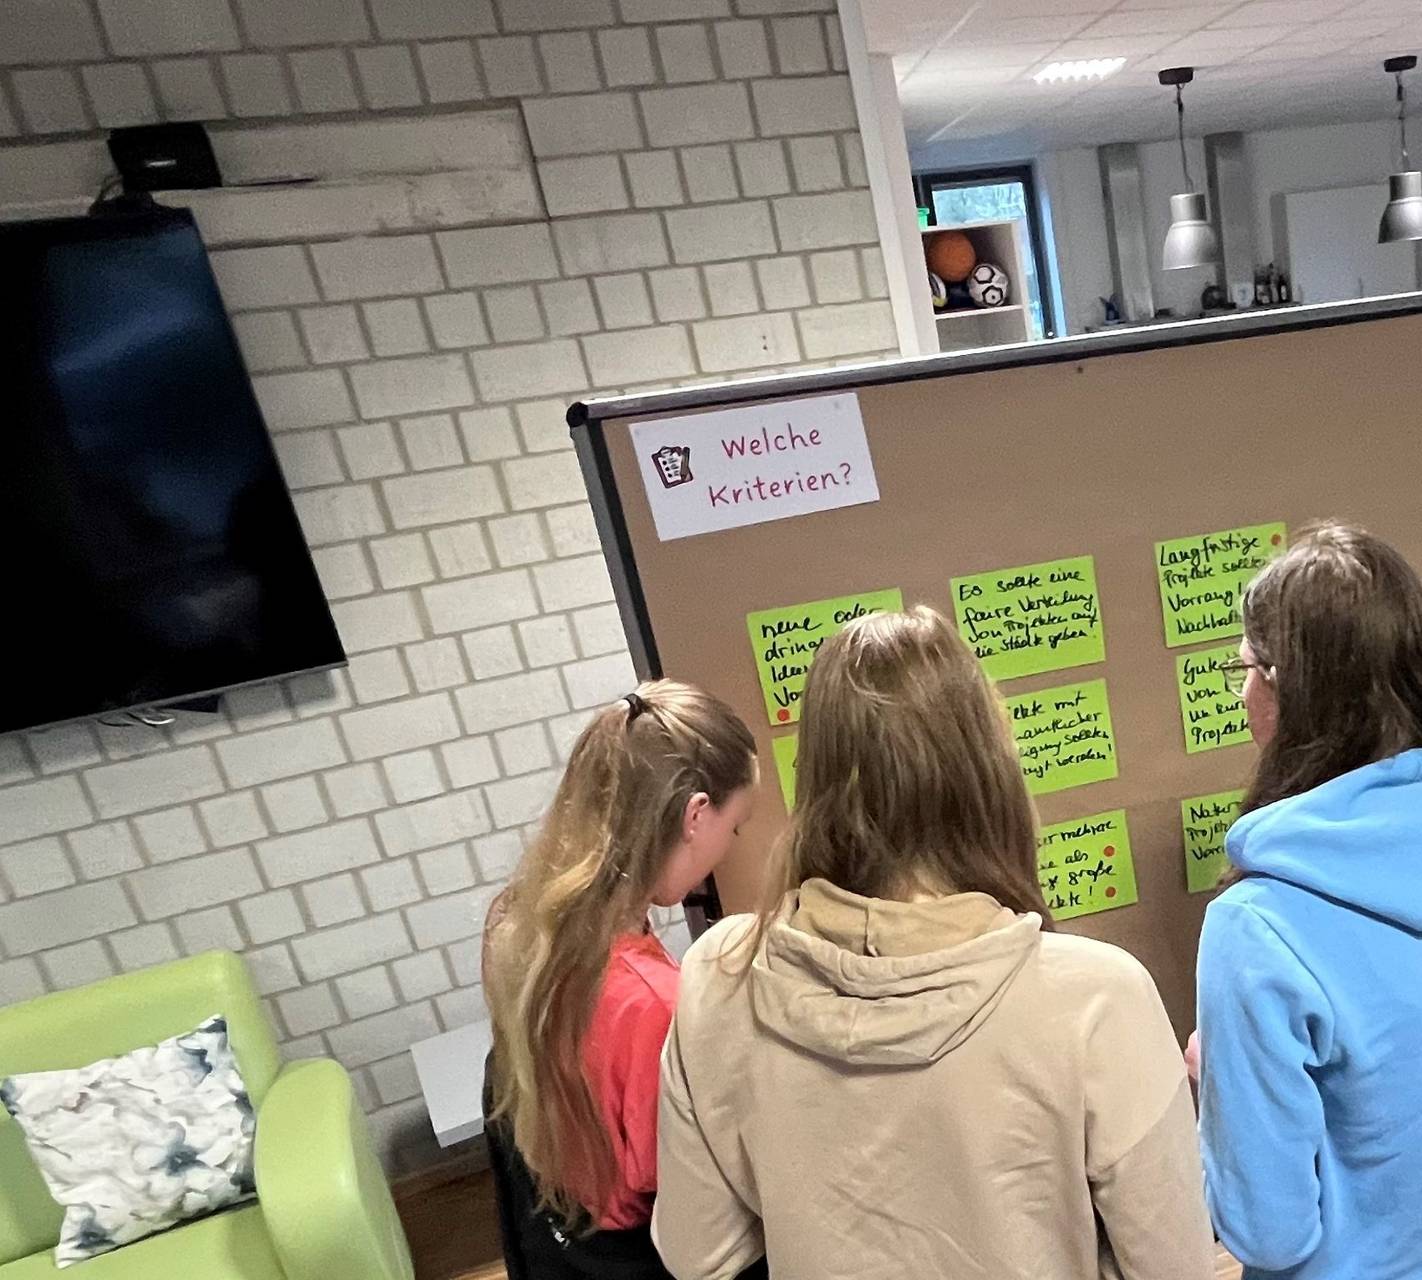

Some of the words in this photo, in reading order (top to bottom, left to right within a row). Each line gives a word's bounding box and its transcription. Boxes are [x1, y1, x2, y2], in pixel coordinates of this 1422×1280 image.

[721, 423, 822, 460] Welche
[708, 463, 852, 508] Kriterien?
[997, 573, 1042, 593] sollte
[1050, 568, 1085, 583] eine
[1018, 590, 1093, 612] Verteilung
[761, 617, 822, 638] neue
[1055, 691, 1087, 710] mit
